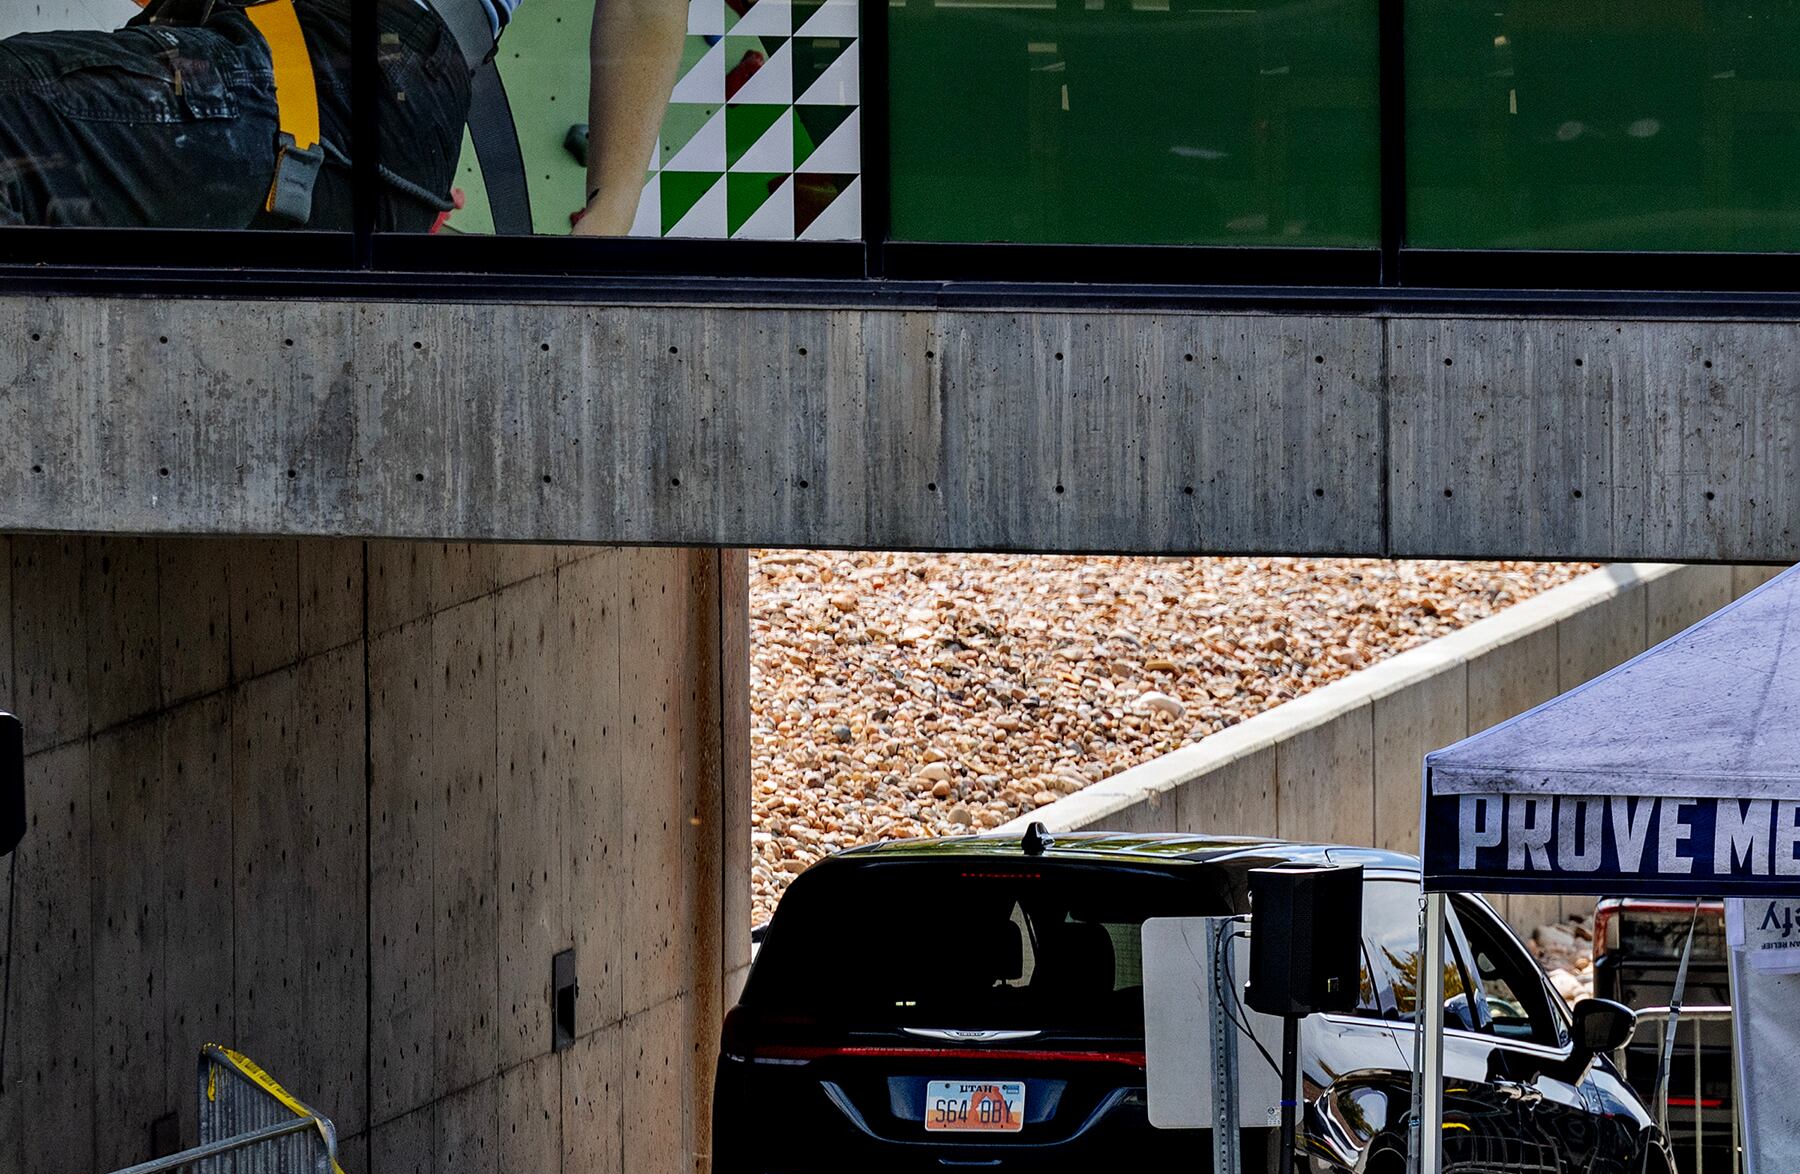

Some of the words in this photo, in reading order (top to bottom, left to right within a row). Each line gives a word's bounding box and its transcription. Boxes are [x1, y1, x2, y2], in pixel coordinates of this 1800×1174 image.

[1458, 793, 1697, 875] PROVE
[1761, 941, 1788, 950] RELIEF
[960, 1085, 992, 1093] UTAH
[936, 1100, 967, 1123] S64
